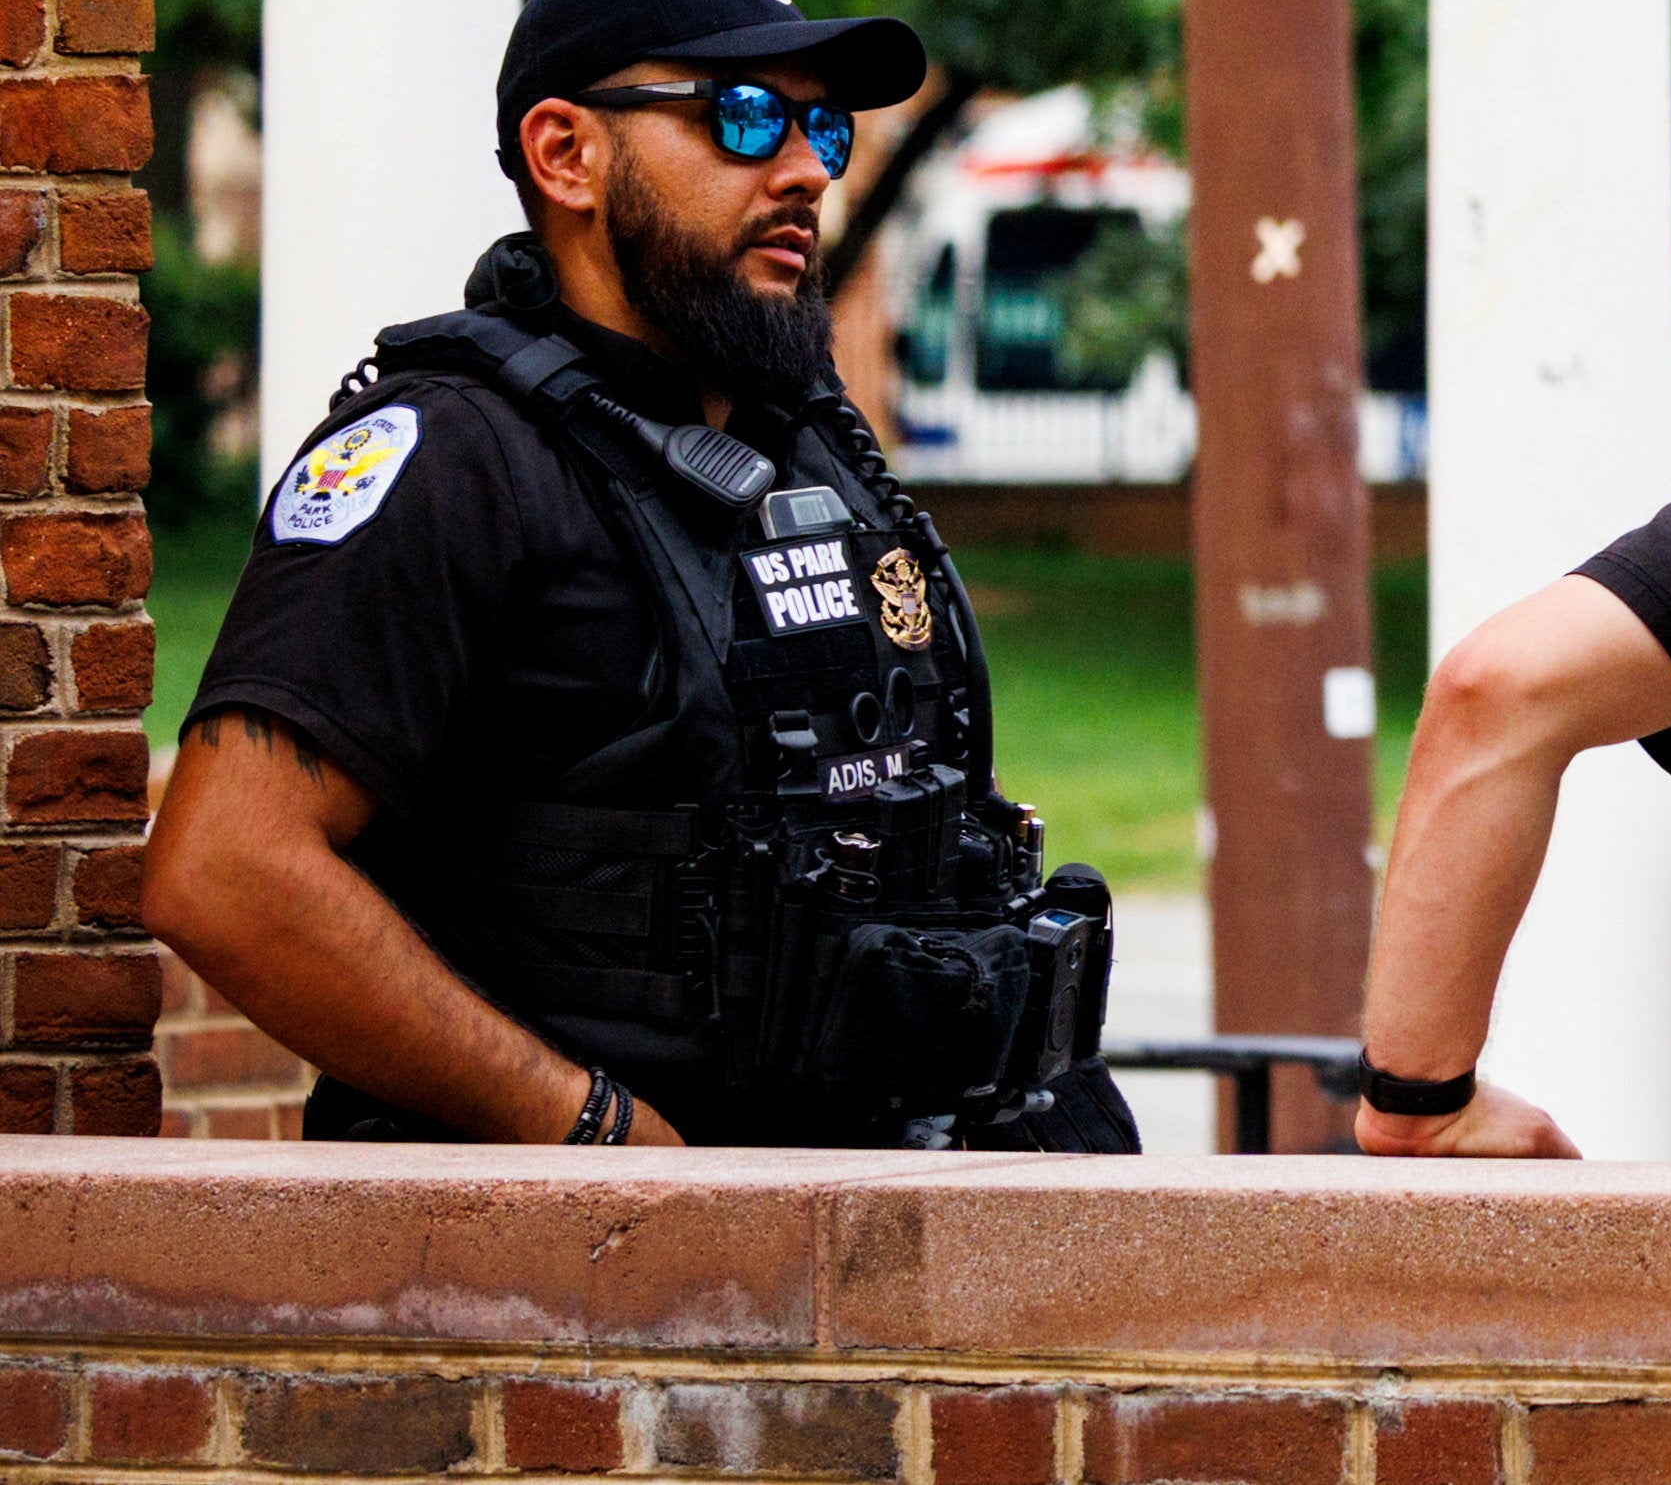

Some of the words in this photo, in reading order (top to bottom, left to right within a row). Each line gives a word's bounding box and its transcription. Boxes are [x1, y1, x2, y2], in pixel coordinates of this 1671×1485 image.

[287, 513, 334, 529] POLICE
[751, 552, 790, 585] US
[787, 540, 848, 579] PARK
[766, 579, 859, 628] POLICE
